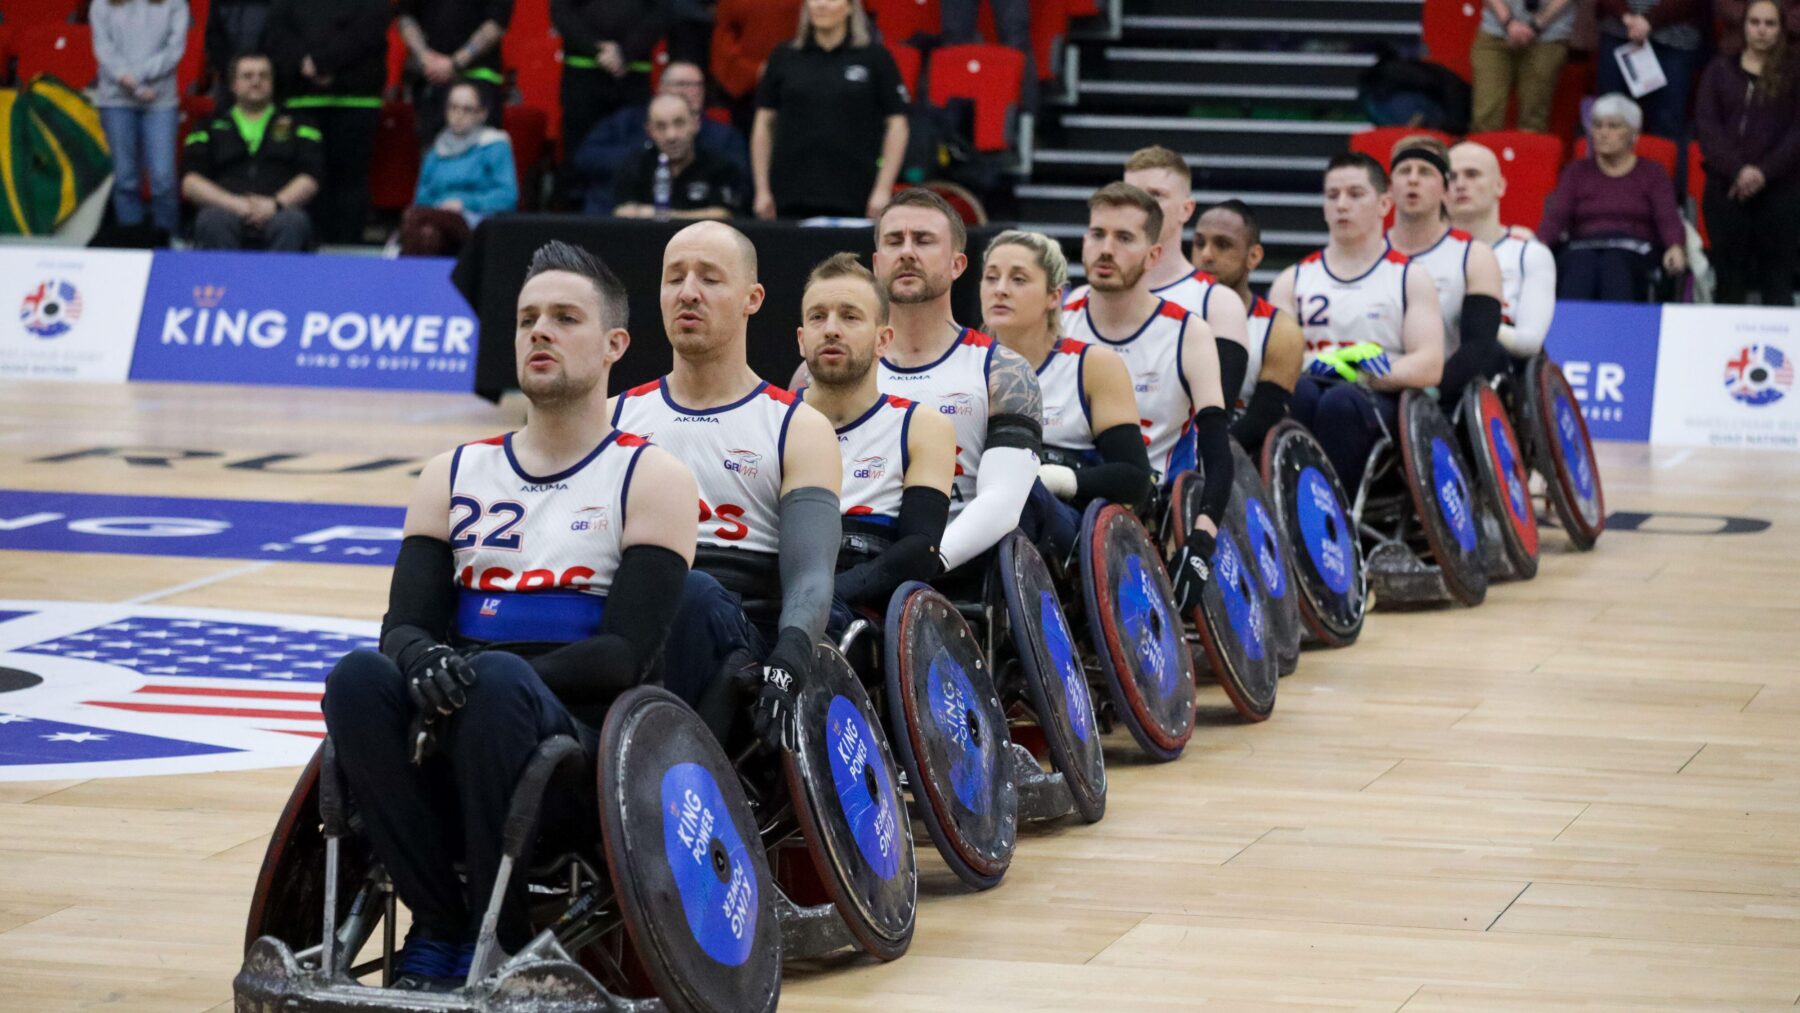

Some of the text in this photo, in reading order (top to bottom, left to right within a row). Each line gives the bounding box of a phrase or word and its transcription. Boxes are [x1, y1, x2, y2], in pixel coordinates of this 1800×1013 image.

[161, 307, 475, 354] KING POWER
[673, 415, 720, 424] AKUMA
[939, 404, 973, 417] GBWR
[520, 483, 569, 493] AKUMA
[723, 458, 759, 479] GBWR
[853, 468, 885, 480] GBWR
[449, 493, 528, 553] 22
[570, 519, 609, 531] GBWR
[482, 597, 501, 611] LP
[836, 717, 859, 765] KING
[849, 738, 868, 782] POWER
[676, 789, 702, 849] KING
[692, 807, 715, 866] POWER
[879, 810, 896, 858] KING
[731, 877, 752, 940] KING
